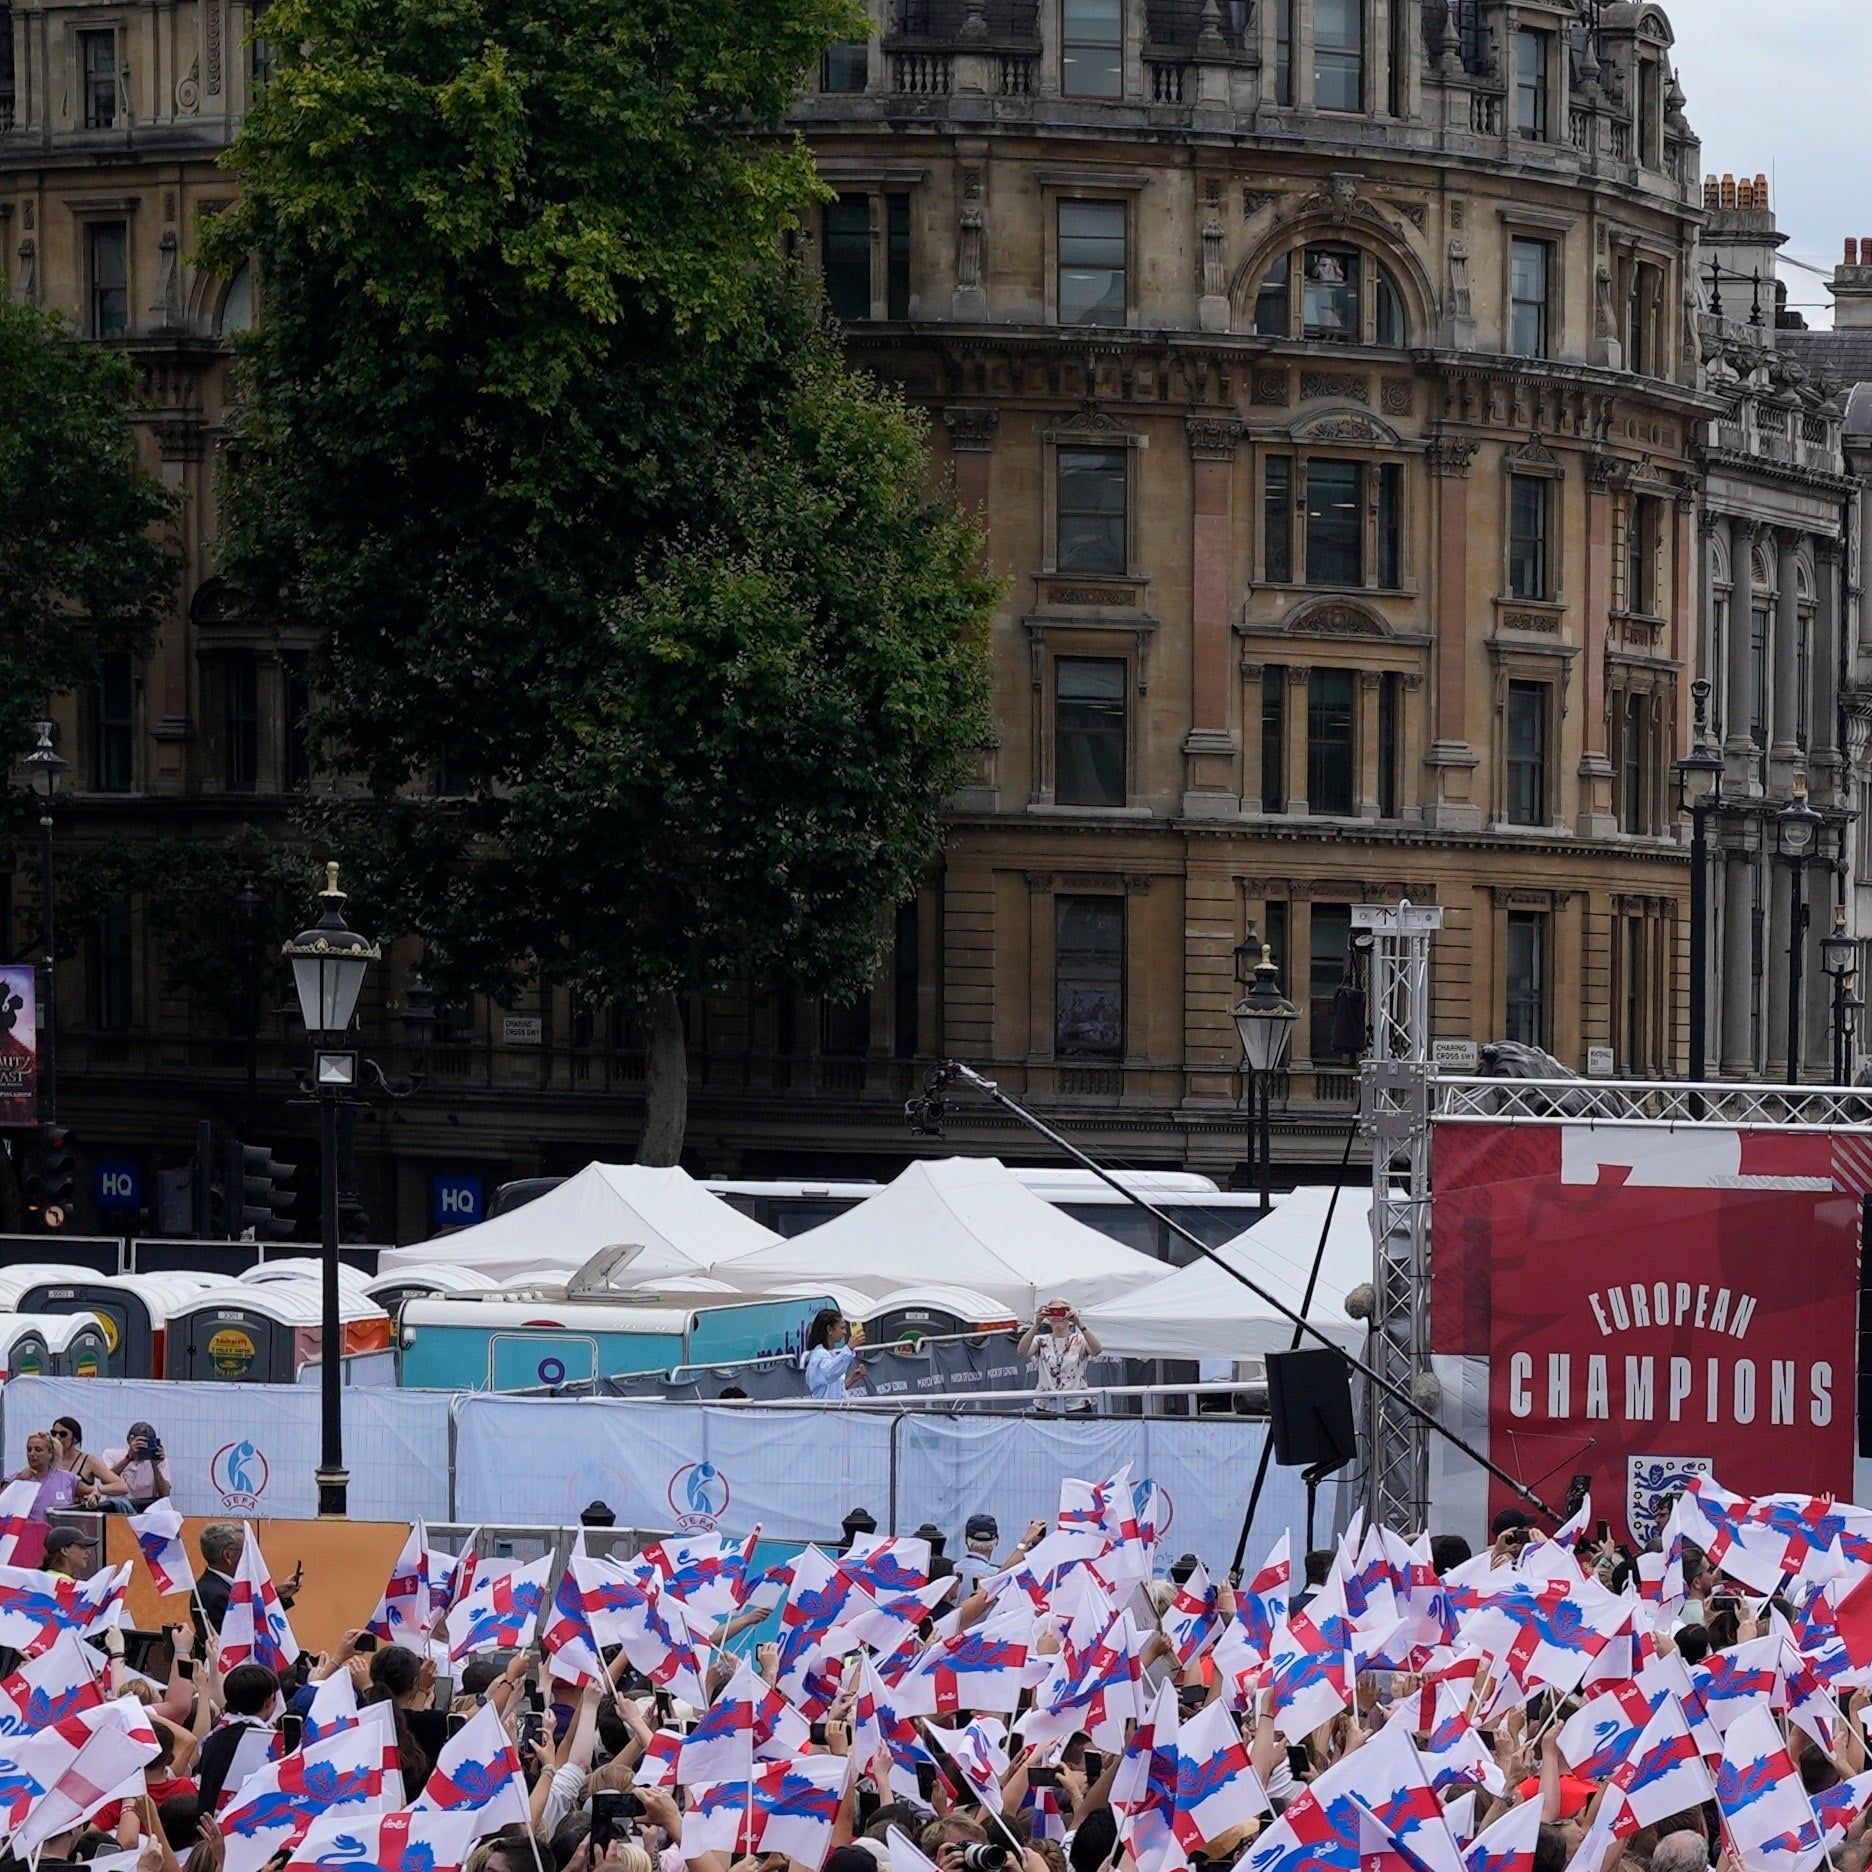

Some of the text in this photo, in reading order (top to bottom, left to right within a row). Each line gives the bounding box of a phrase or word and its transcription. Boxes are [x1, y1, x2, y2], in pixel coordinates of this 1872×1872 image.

[102, 1172, 133, 1197] HQ
[441, 1187, 475, 1214] HQ
[1588, 1282, 1757, 1340] EUROPEAN
[1509, 1351, 1834, 1427] CHAMPIONS
[223, 1496, 257, 1509] UEFA
[679, 1515, 715, 1531] UEFA
